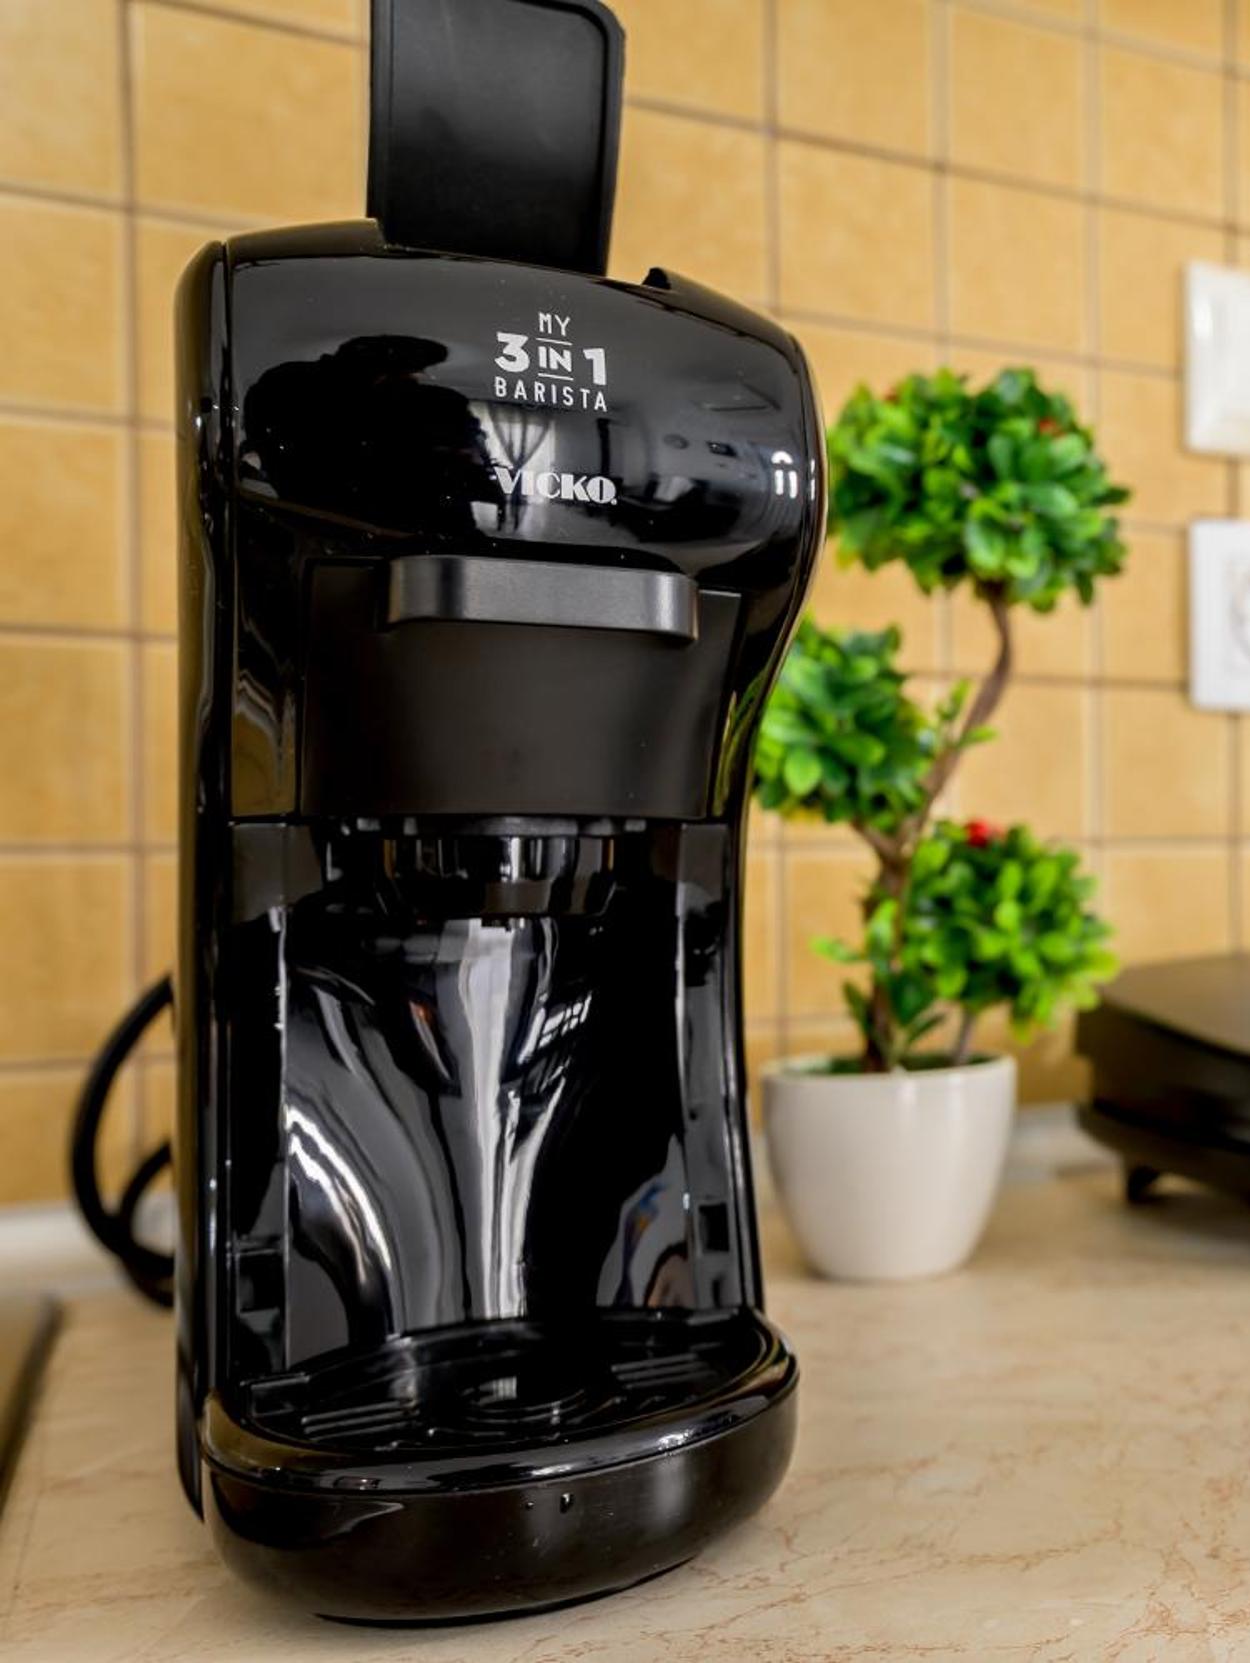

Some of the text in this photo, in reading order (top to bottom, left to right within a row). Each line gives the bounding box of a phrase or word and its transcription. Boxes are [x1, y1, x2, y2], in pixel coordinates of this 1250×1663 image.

[538, 312, 571, 336] MY
[494, 331, 607, 386] 3 IN 1
[494, 376, 607, 412] BARISTA
